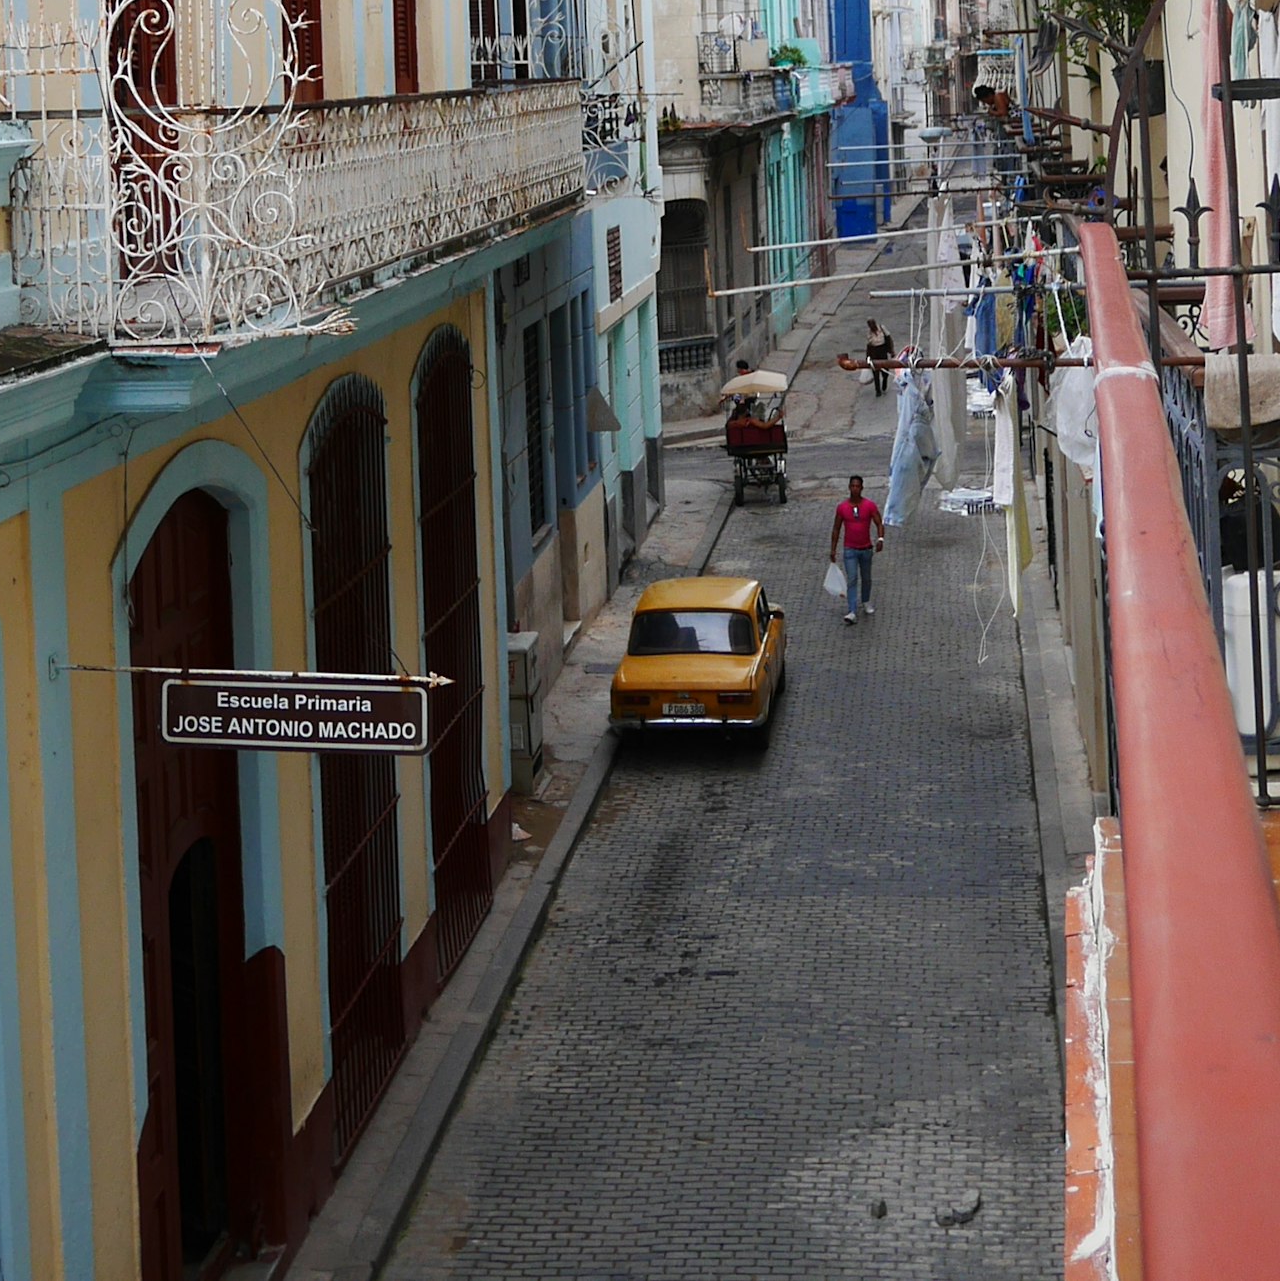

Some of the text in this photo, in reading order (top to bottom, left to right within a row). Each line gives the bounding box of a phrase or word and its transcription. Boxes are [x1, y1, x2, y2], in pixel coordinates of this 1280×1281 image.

[217, 692, 372, 712] Escuela Primaria
[173, 715, 416, 740] JOSE ANTONIO MACHADO
